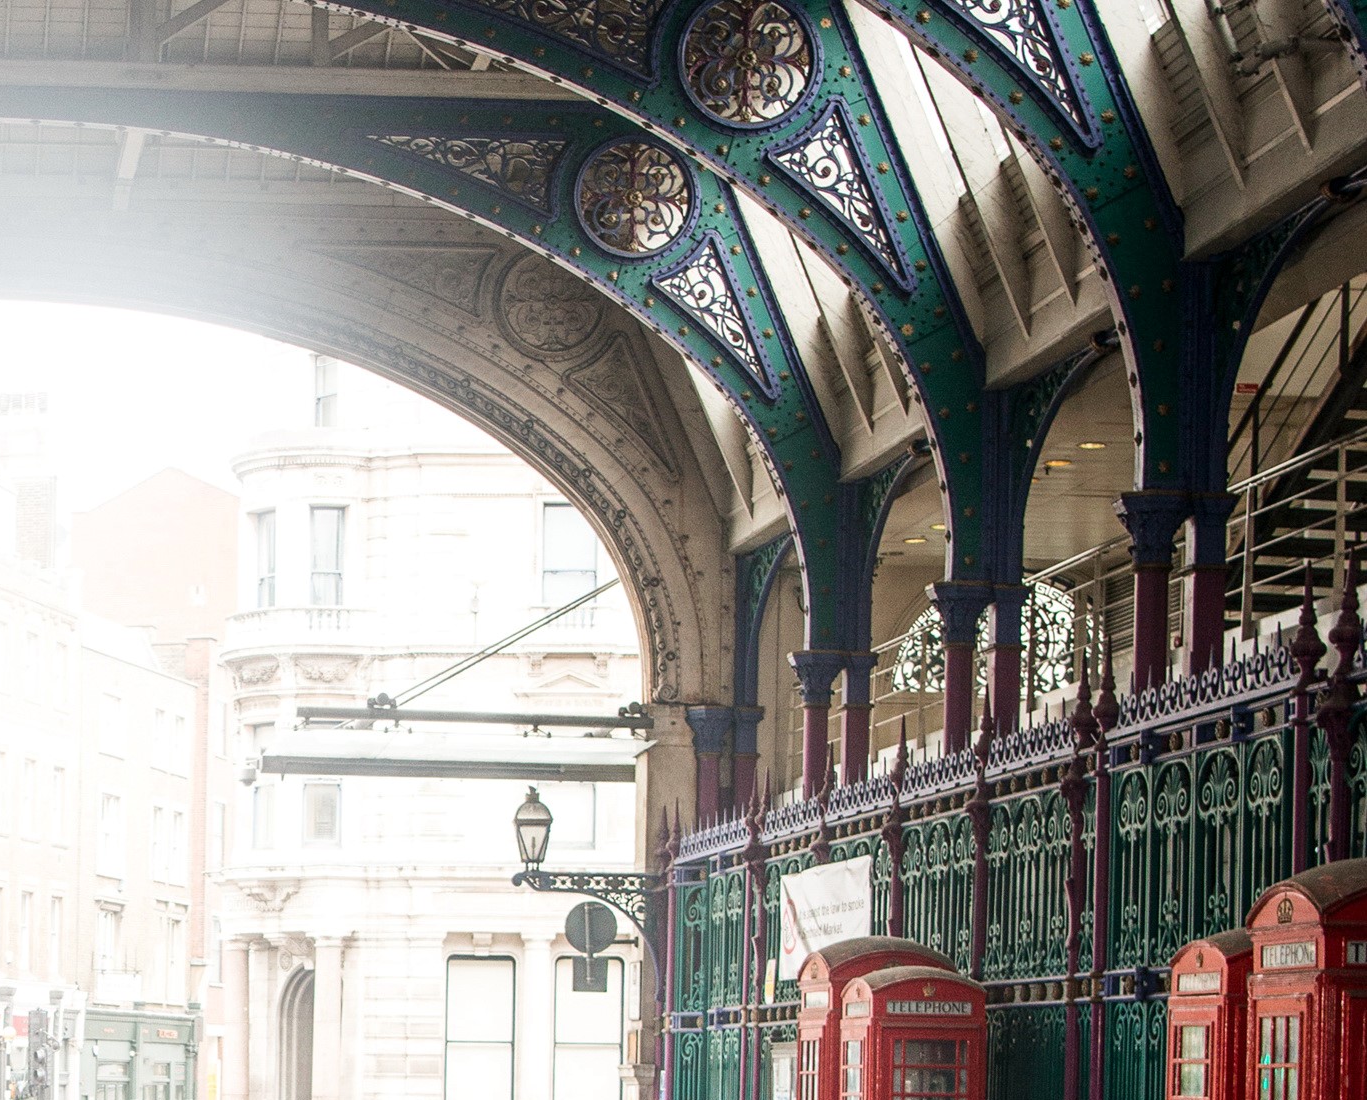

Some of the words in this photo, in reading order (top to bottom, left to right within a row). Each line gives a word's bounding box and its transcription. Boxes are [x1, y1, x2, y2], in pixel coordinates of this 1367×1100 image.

[841, 900, 847, 913] to
[847, 897, 865, 913] smoke
[1264, 941, 1316, 968] TELEPHONE
[1350, 942, 1367, 963] T
[891, 1001, 970, 1013] TELEPHONE
